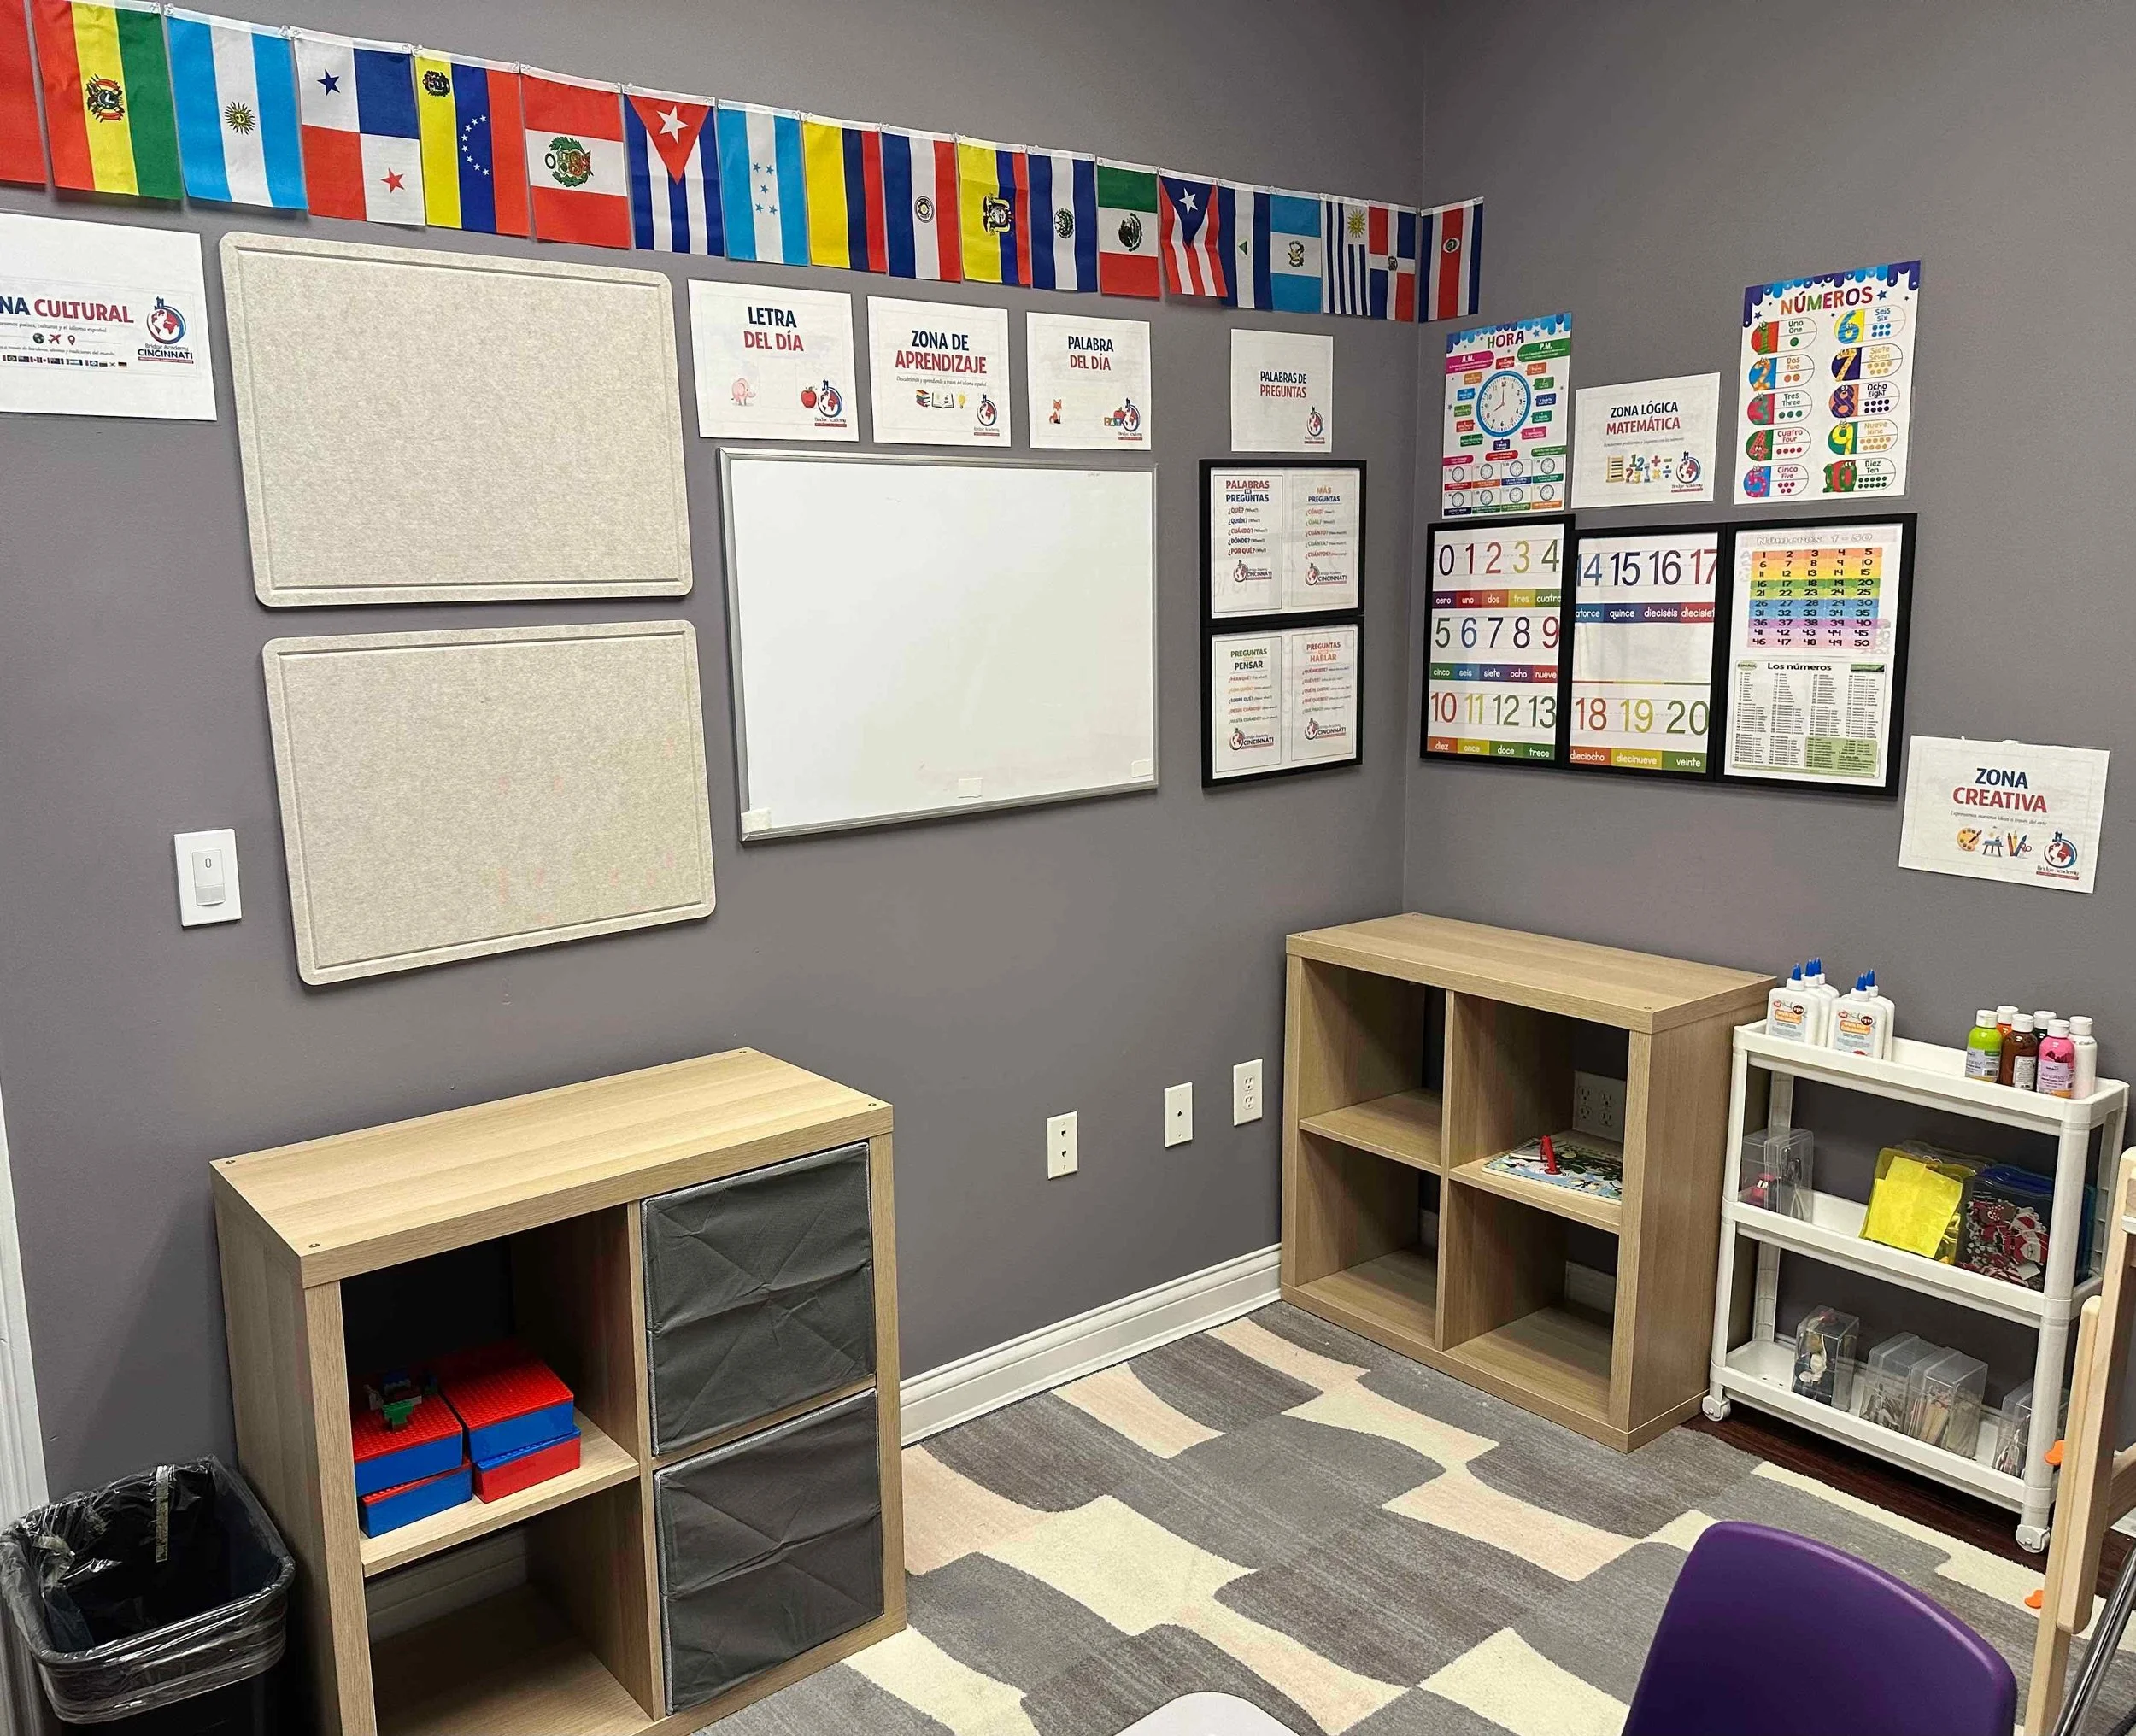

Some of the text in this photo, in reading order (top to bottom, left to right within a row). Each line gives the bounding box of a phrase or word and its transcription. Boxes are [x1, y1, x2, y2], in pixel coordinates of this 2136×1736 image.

[1781, 286, 1874, 316] NÚMEROS
[34, 299, 134, 323] CULTURAL
[748, 306, 797, 328] LETRA
[1838, 309, 1860, 344] 6
[743, 330, 804, 351] DEL DÍA
[912, 330, 969, 351] ZONA DE
[1068, 336, 1114, 352] PALABRA
[1487, 331, 1524, 349] HORA
[138, 349, 193, 359] CINCINNATI
[895, 350, 987, 374] APRENDIZAJE
[1070, 354, 1111, 371] DEL DÍA
[1753, 357, 1771, 391] 2
[1834, 348, 1857, 383] 7
[1260, 371, 1306, 384] PALABRAS DE
[1260, 384, 1306, 398] PREGUNTAS
[1611, 401, 1678, 418] ZONA LÓGICA
[1831, 384, 1854, 418] 8
[1606, 416, 1681, 435] MATEMÁTICA
[1749, 429, 1769, 461] 4
[1832, 420, 1854, 455] 9
[1226, 480, 1270, 489] PALABRAS
[1823, 459, 1857, 493] 10
[1226, 494, 1269, 502] PREGUNTAS
[1317, 485, 1331, 494] MÁS
[1228, 506, 1244, 514] ¿QUÉ?
[1439, 539, 1560, 576] 0 1 2 3 4
[1576, 548, 1717, 586] 14 15 16 17
[1488, 594, 1500, 604] dos
[1514, 594, 1529, 603] tres
[1610, 608, 1635, 619] quince
[1644, 607, 1678, 618] dieciséis
[1435, 616, 1559, 649] 5 6 7 8 9
[1230, 648, 1267, 658] PREGUNTAS
[1306, 642, 1341, 650] PREGUNTAS
[1235, 660, 1263, 670] PENSAR
[1311, 654, 1336, 662] HABLAR
[1787, 662, 1832, 671] números
[1433, 668, 1450, 677] cinco
[1484, 669, 1500, 678] siete
[1511, 670, 1528, 678] ocho
[1535, 671, 1557, 679] nueve
[1430, 692, 1556, 729] 10 11 12 13
[1576, 697, 1710, 736] 18 19 20
[1435, 742, 1449, 751] diez
[1498, 745, 1515, 755] doce
[1529, 748, 1550, 758] trece
[1570, 750, 1700, 767] dieciocho diecinueve veinte
[1975, 767, 2028, 789] ZONA
[1952, 787, 2047, 813] CREATIVA
